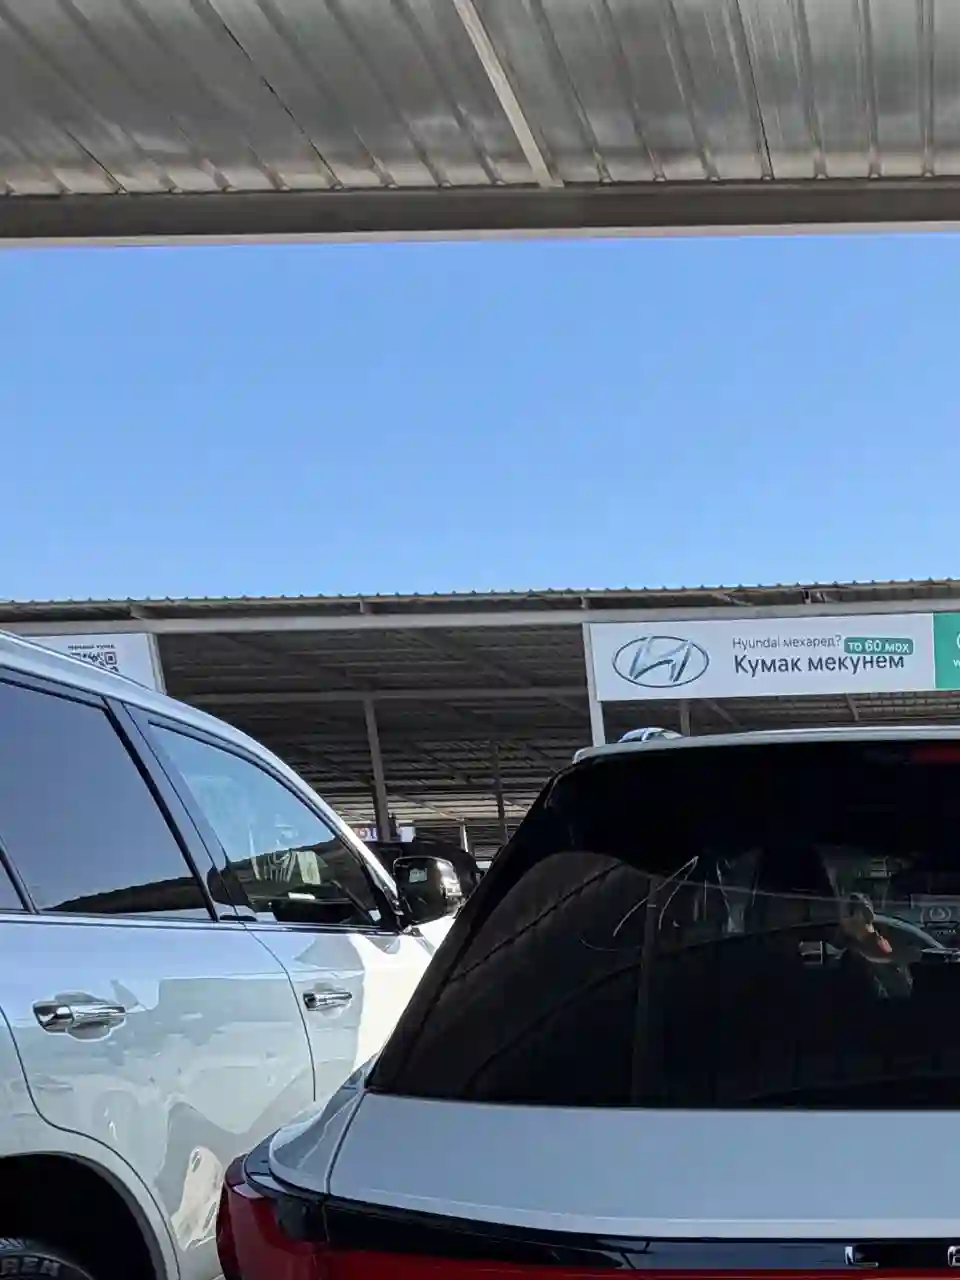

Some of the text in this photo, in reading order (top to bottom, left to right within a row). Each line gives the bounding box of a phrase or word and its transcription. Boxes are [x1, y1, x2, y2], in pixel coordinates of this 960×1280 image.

[733, 635, 780, 650] Hyundai
[865, 639, 882, 653] 60
[734, 653, 905, 678] Кумак мекунем
